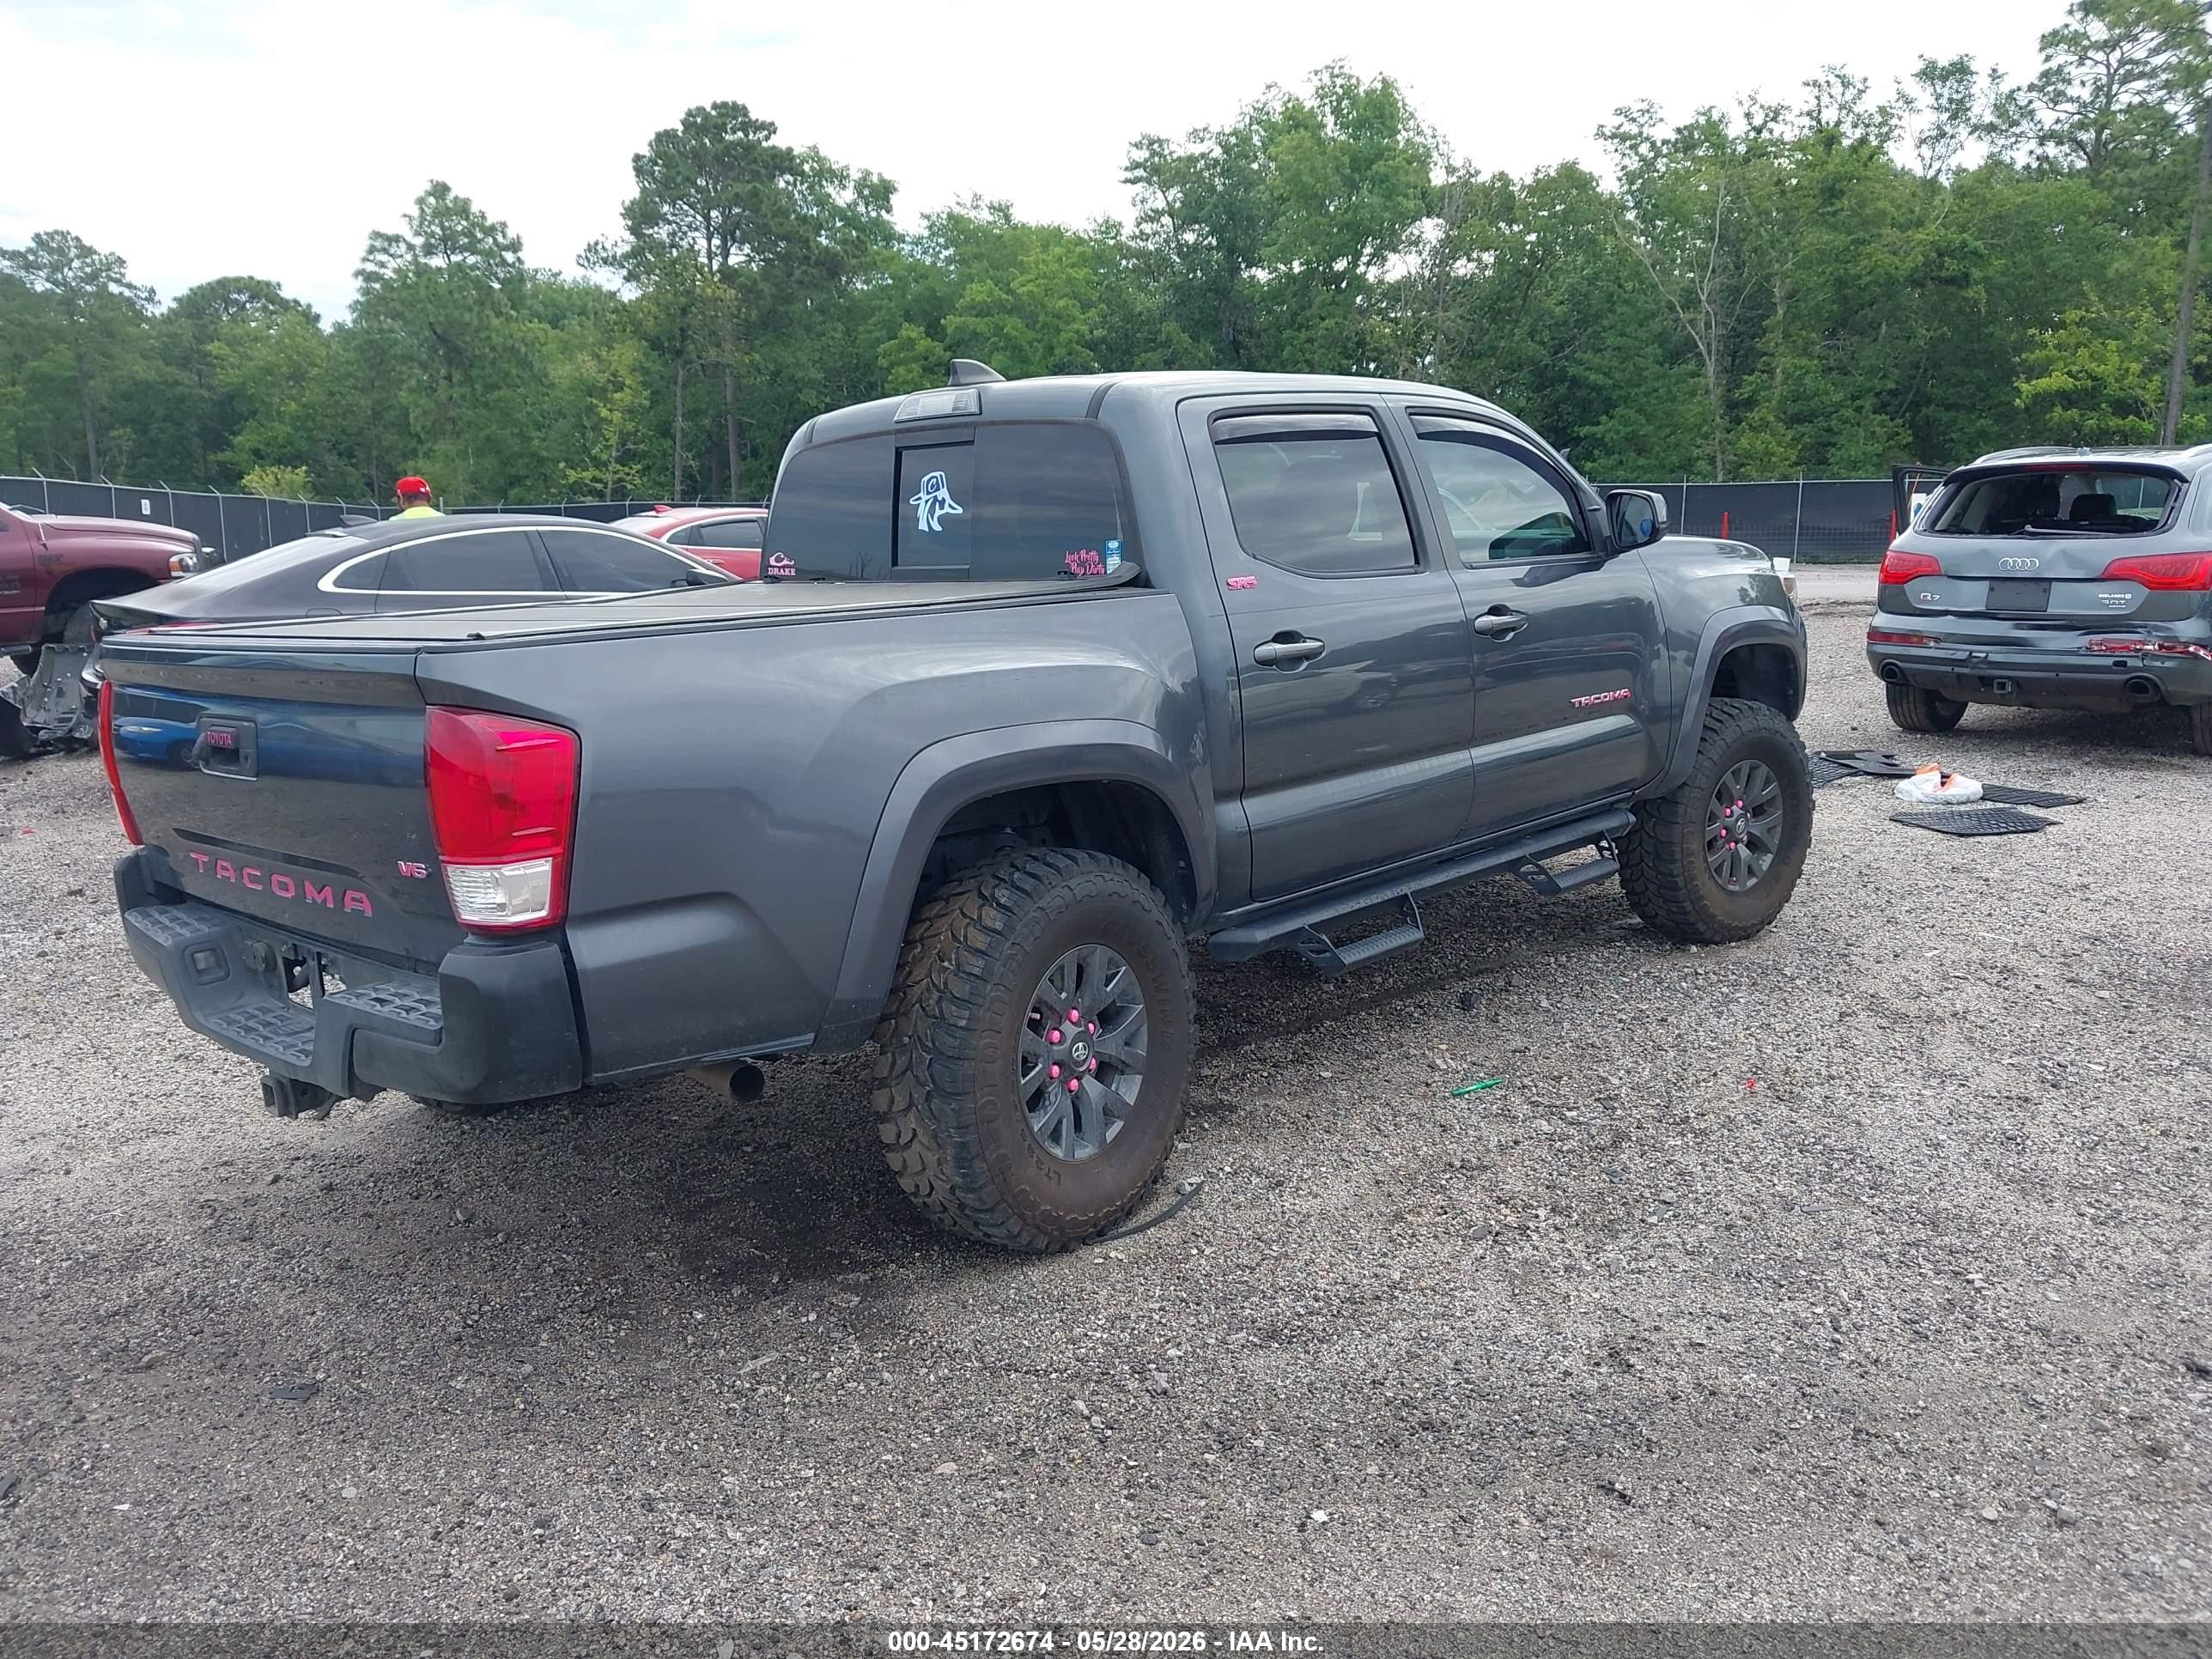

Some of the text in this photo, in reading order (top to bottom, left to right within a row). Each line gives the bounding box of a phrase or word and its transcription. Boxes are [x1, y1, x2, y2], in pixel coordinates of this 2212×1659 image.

[1065, 550, 1080, 563] Look
[1079, 549, 1099, 565] Pretty
[768, 567, 797, 576] DRAKE
[1085, 561, 1105, 576] Dirty
[1920, 592, 1941, 602] Q7
[1569, 688, 1632, 708] TACOMA
[206, 731, 232, 746] TOYOTA
[397, 860, 428, 879] V6
[189, 851, 373, 917] TACOMA
